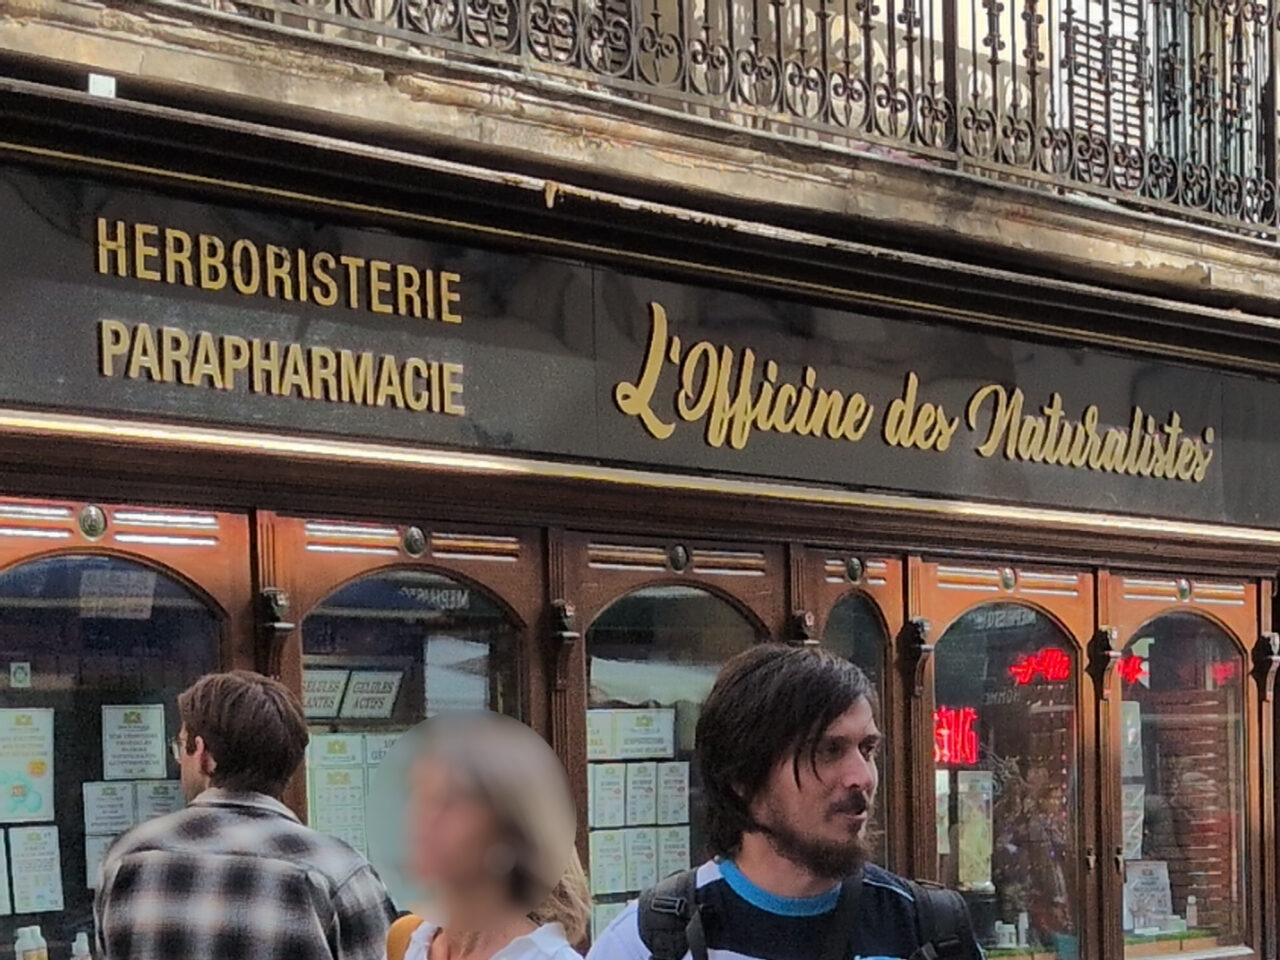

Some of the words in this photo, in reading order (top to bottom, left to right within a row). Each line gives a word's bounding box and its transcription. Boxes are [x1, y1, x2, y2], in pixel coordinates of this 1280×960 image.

[96, 217, 464, 324] HERBORISTERIE
[99, 319, 467, 415] PARAPHARMACIE
[615, 302, 874, 449] L'Officine
[884, 371, 959, 452] des
[968, 384, 1213, 482] Naturalistes
